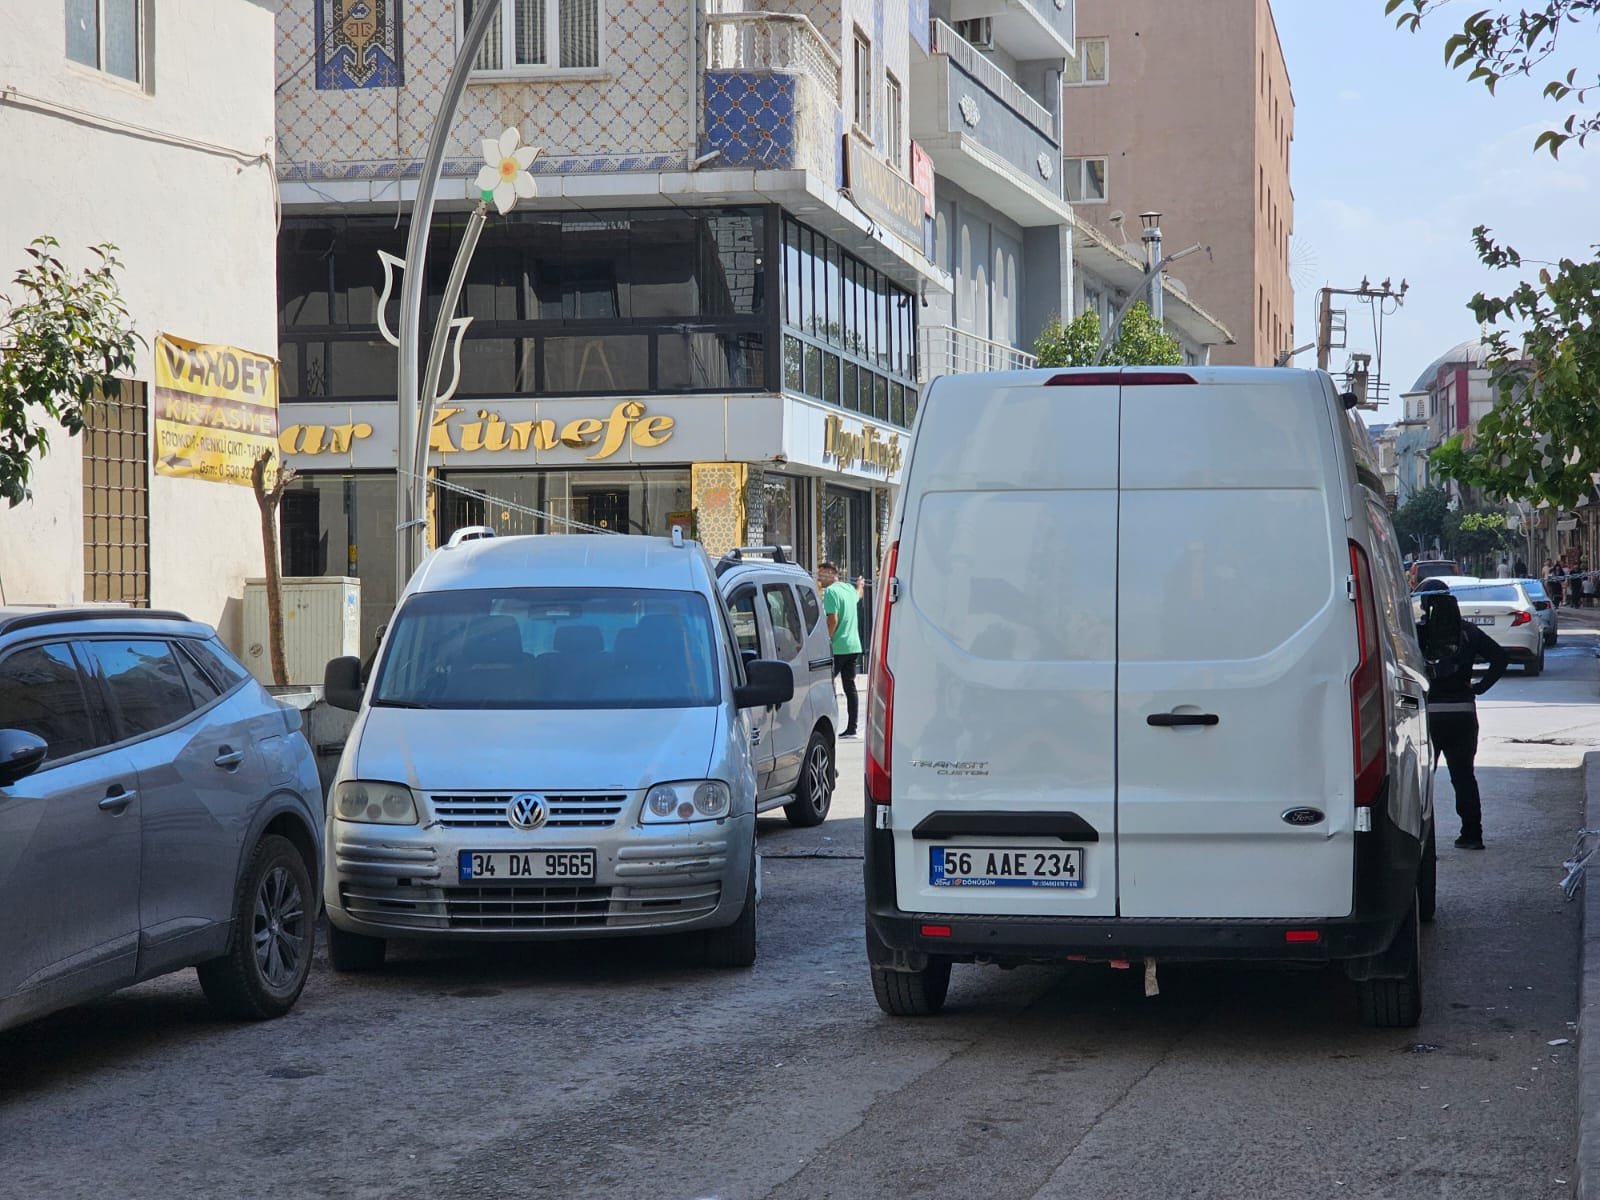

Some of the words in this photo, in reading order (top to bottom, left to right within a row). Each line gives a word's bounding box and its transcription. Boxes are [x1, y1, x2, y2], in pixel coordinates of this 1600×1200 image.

[429, 401, 675, 461] Künefe
[472, 854, 496, 876] 34
[509, 854, 532, 876] DA
[545, 854, 592, 877] 9565
[944, 852, 972, 875] 56
[986, 852, 1028, 876] AAE
[1034, 853, 1076, 878] 234
